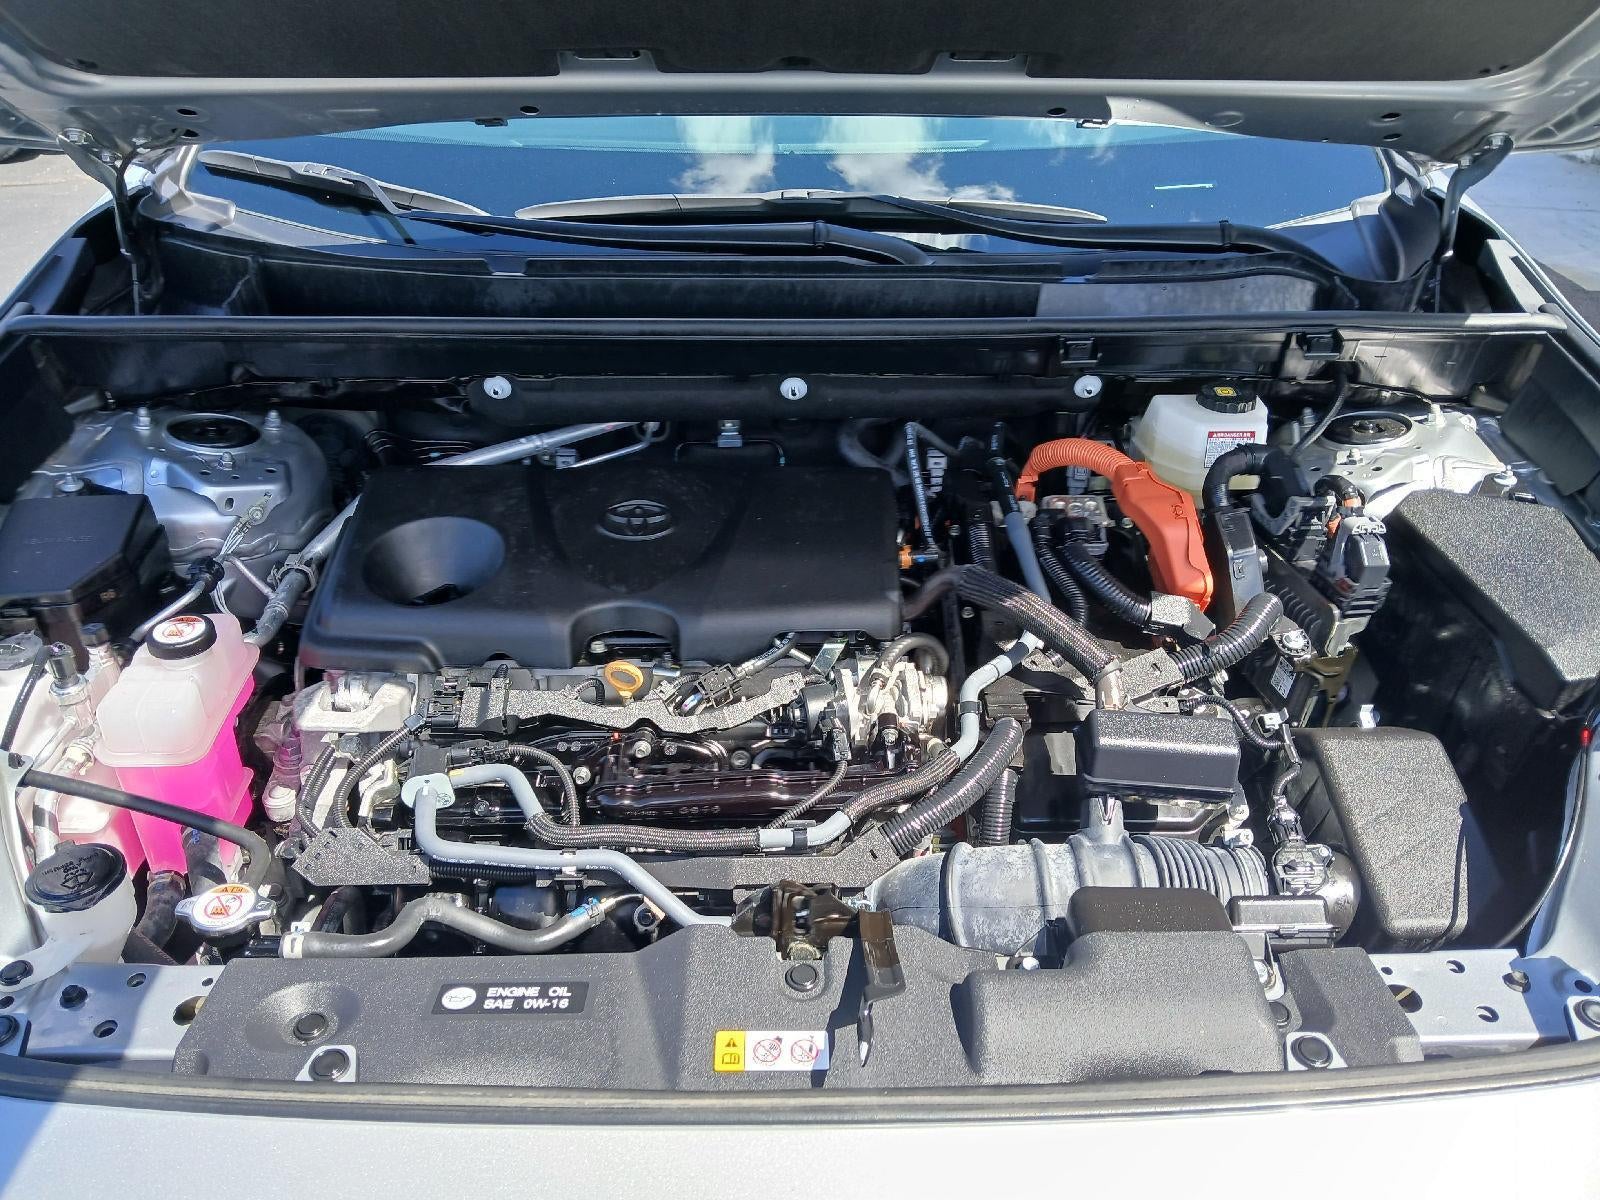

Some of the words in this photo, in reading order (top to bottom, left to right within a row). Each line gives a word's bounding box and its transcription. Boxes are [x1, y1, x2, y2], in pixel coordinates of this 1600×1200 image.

[486, 986, 541, 998] ENGINE
[548, 986, 572, 997] OIL
[483, 998, 515, 1010] SAE
[523, 998, 570, 1010] 0W-16
